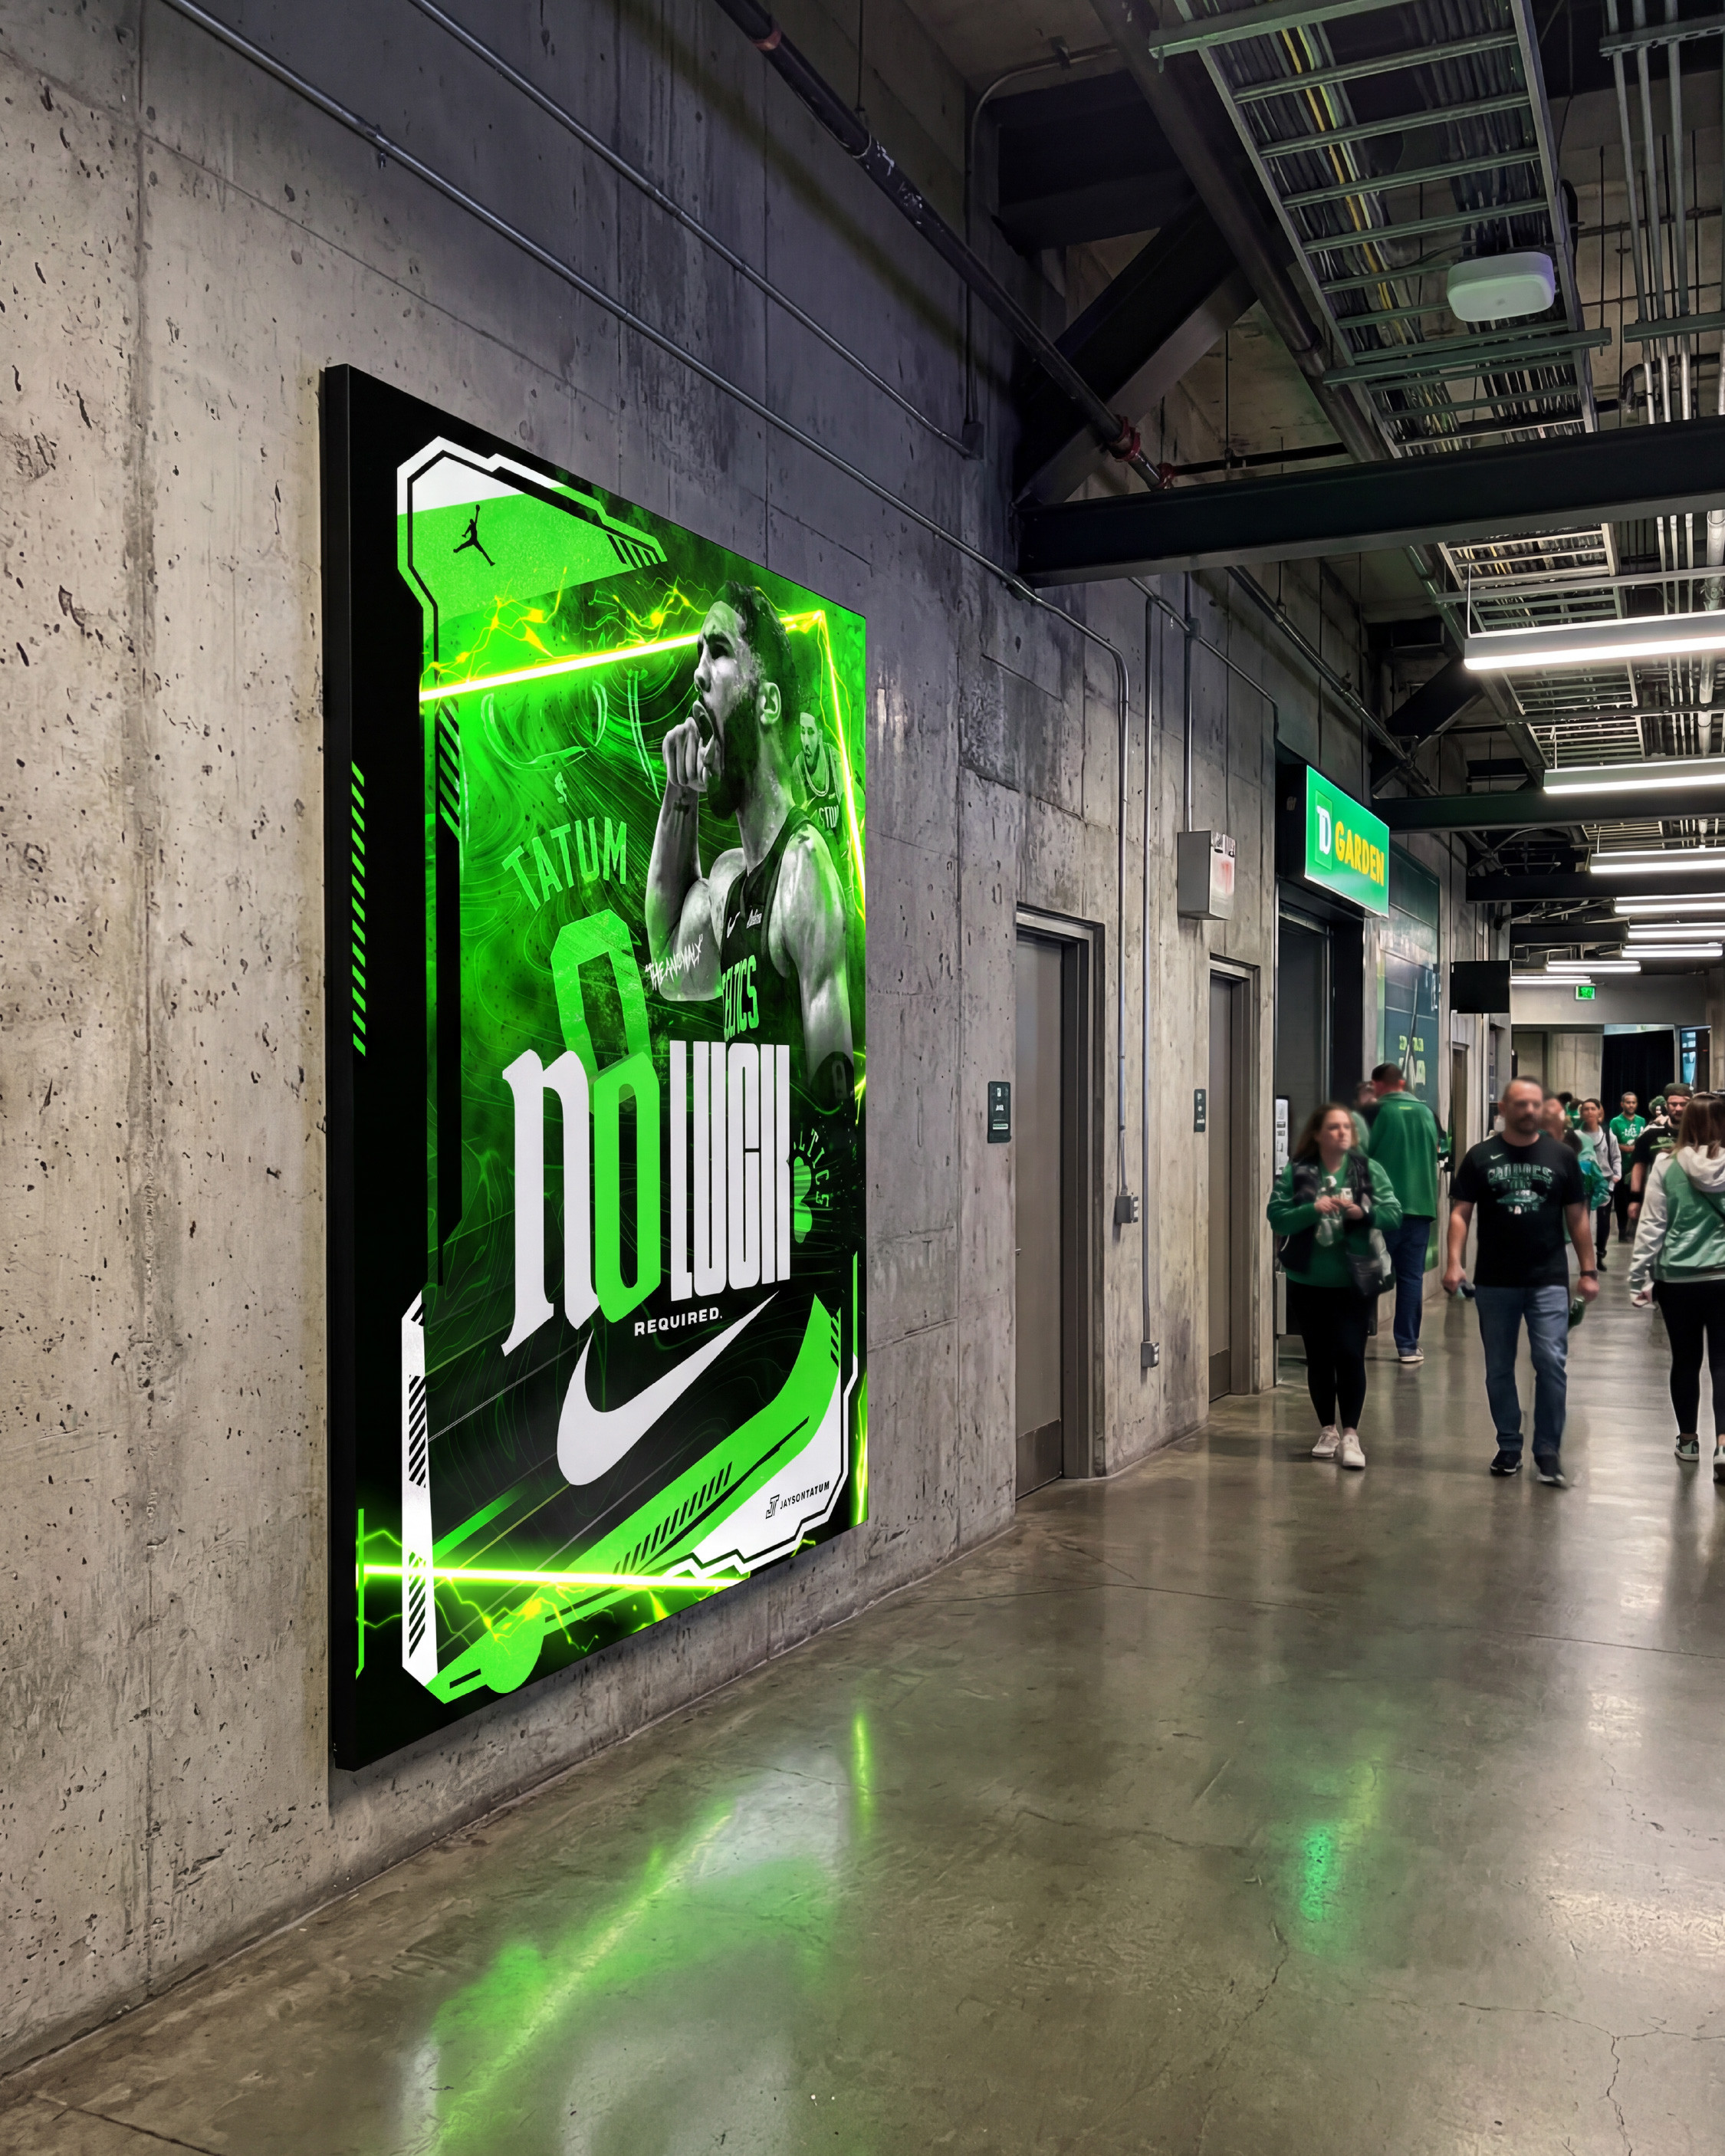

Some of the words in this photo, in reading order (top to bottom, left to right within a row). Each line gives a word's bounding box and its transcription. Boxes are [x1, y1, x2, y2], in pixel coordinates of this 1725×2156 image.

[501, 817, 627, 911] TATUM
[1316, 805, 1332, 855] TD
[1335, 821, 1385, 886] GARDEN
[669, 1040, 790, 1302] LUCK
[634, 1306, 723, 1336] REQUIRED.
